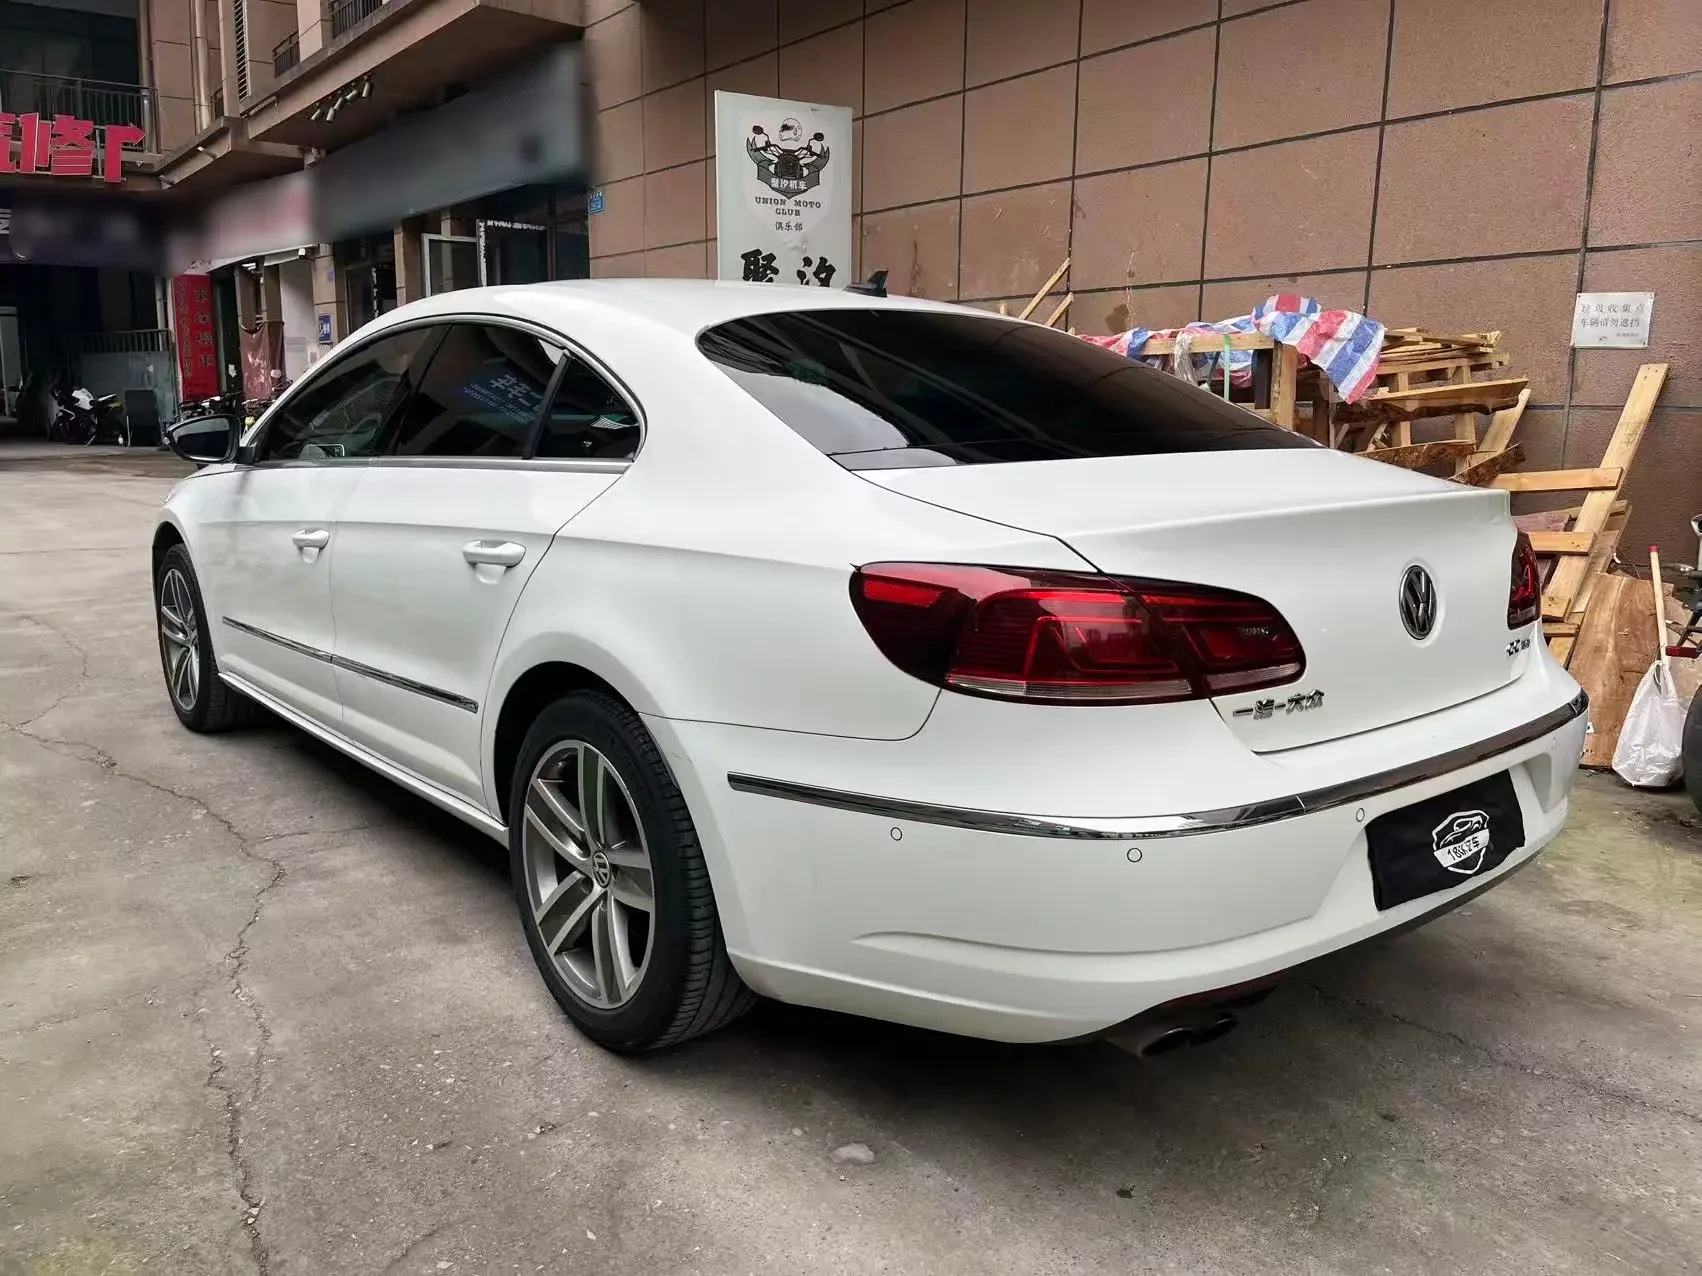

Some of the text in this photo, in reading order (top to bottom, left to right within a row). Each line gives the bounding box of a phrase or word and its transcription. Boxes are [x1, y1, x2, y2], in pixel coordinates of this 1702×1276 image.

[754, 196, 822, 209] UNION MOTO
[775, 208, 801, 217] CLUB
[775, 220, 803, 232] 俱乐部
[1581, 303, 1645, 314] 垃圾收集点
[1580, 317, 1640, 329] 车辆请勿遮挡
